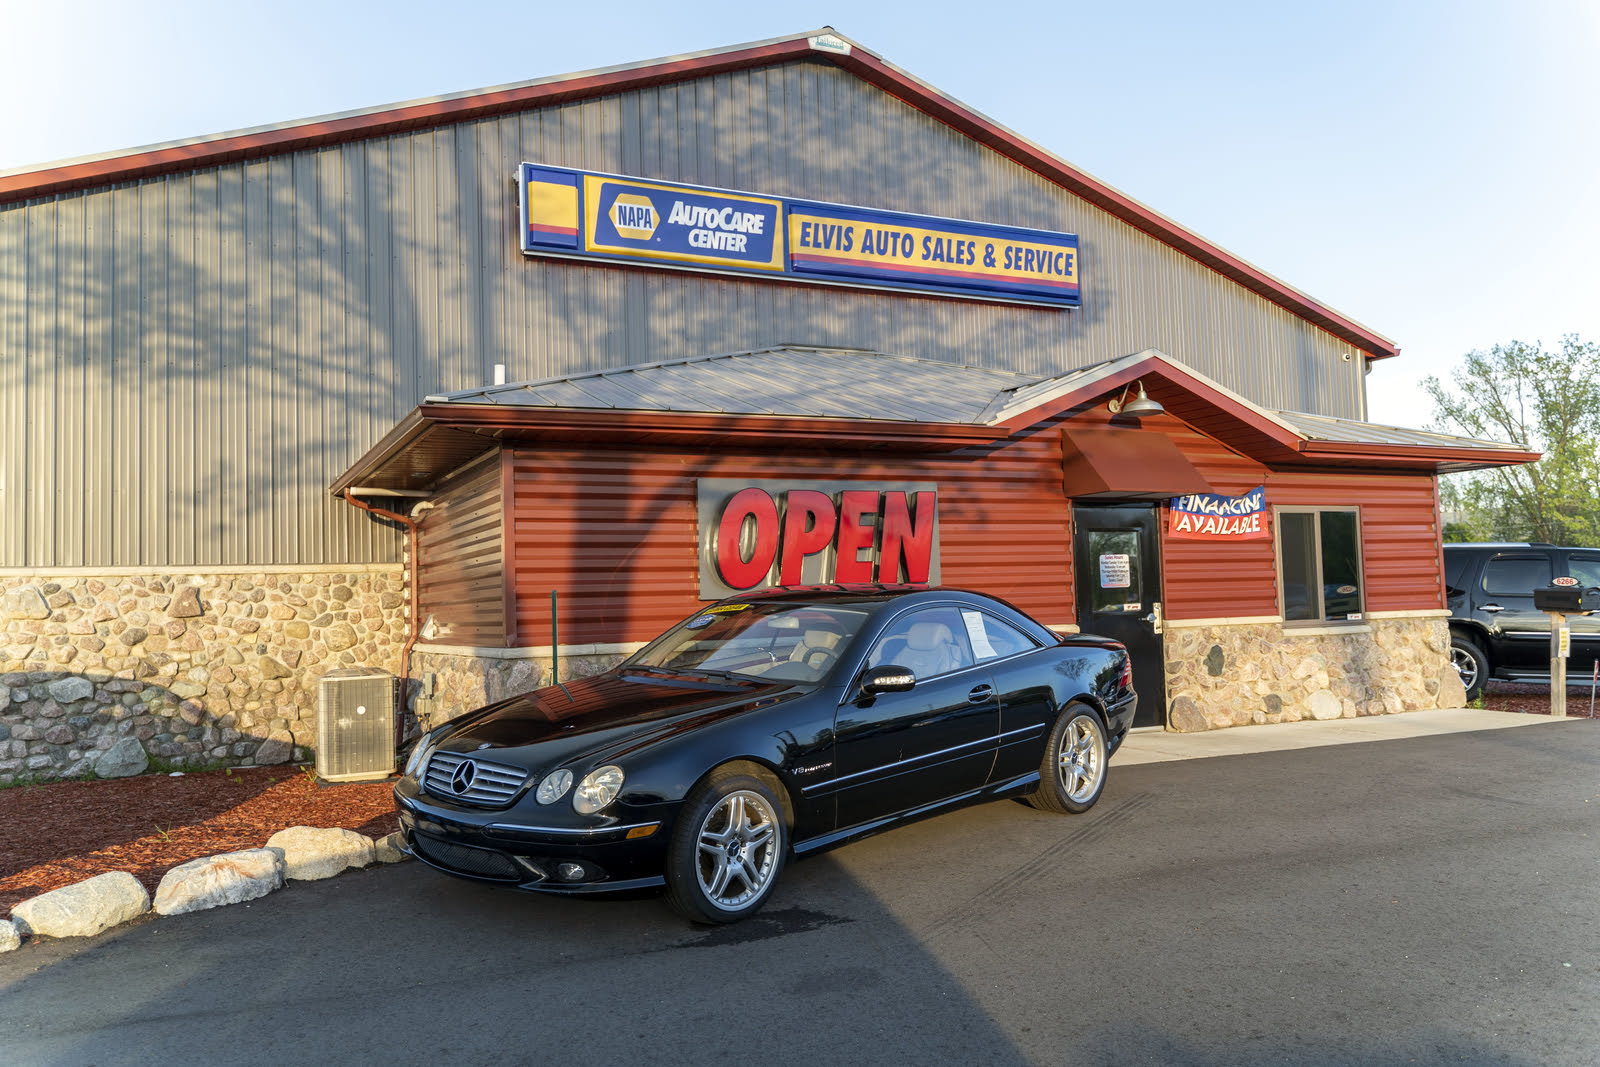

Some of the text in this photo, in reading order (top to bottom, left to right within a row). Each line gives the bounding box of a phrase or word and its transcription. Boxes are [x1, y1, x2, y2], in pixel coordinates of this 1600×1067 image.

[617, 204, 653, 230] NAPA
[667, 200, 765, 235] AUTOCARE
[688, 228, 748, 253] CENTER
[800, 221, 1073, 276] ELVIS AUTO SALES & SERVICE
[1178, 493, 1262, 516] FINANCIN
[1176, 513, 1261, 535] AVAILABLE
[717, 487, 936, 590] OPEN
